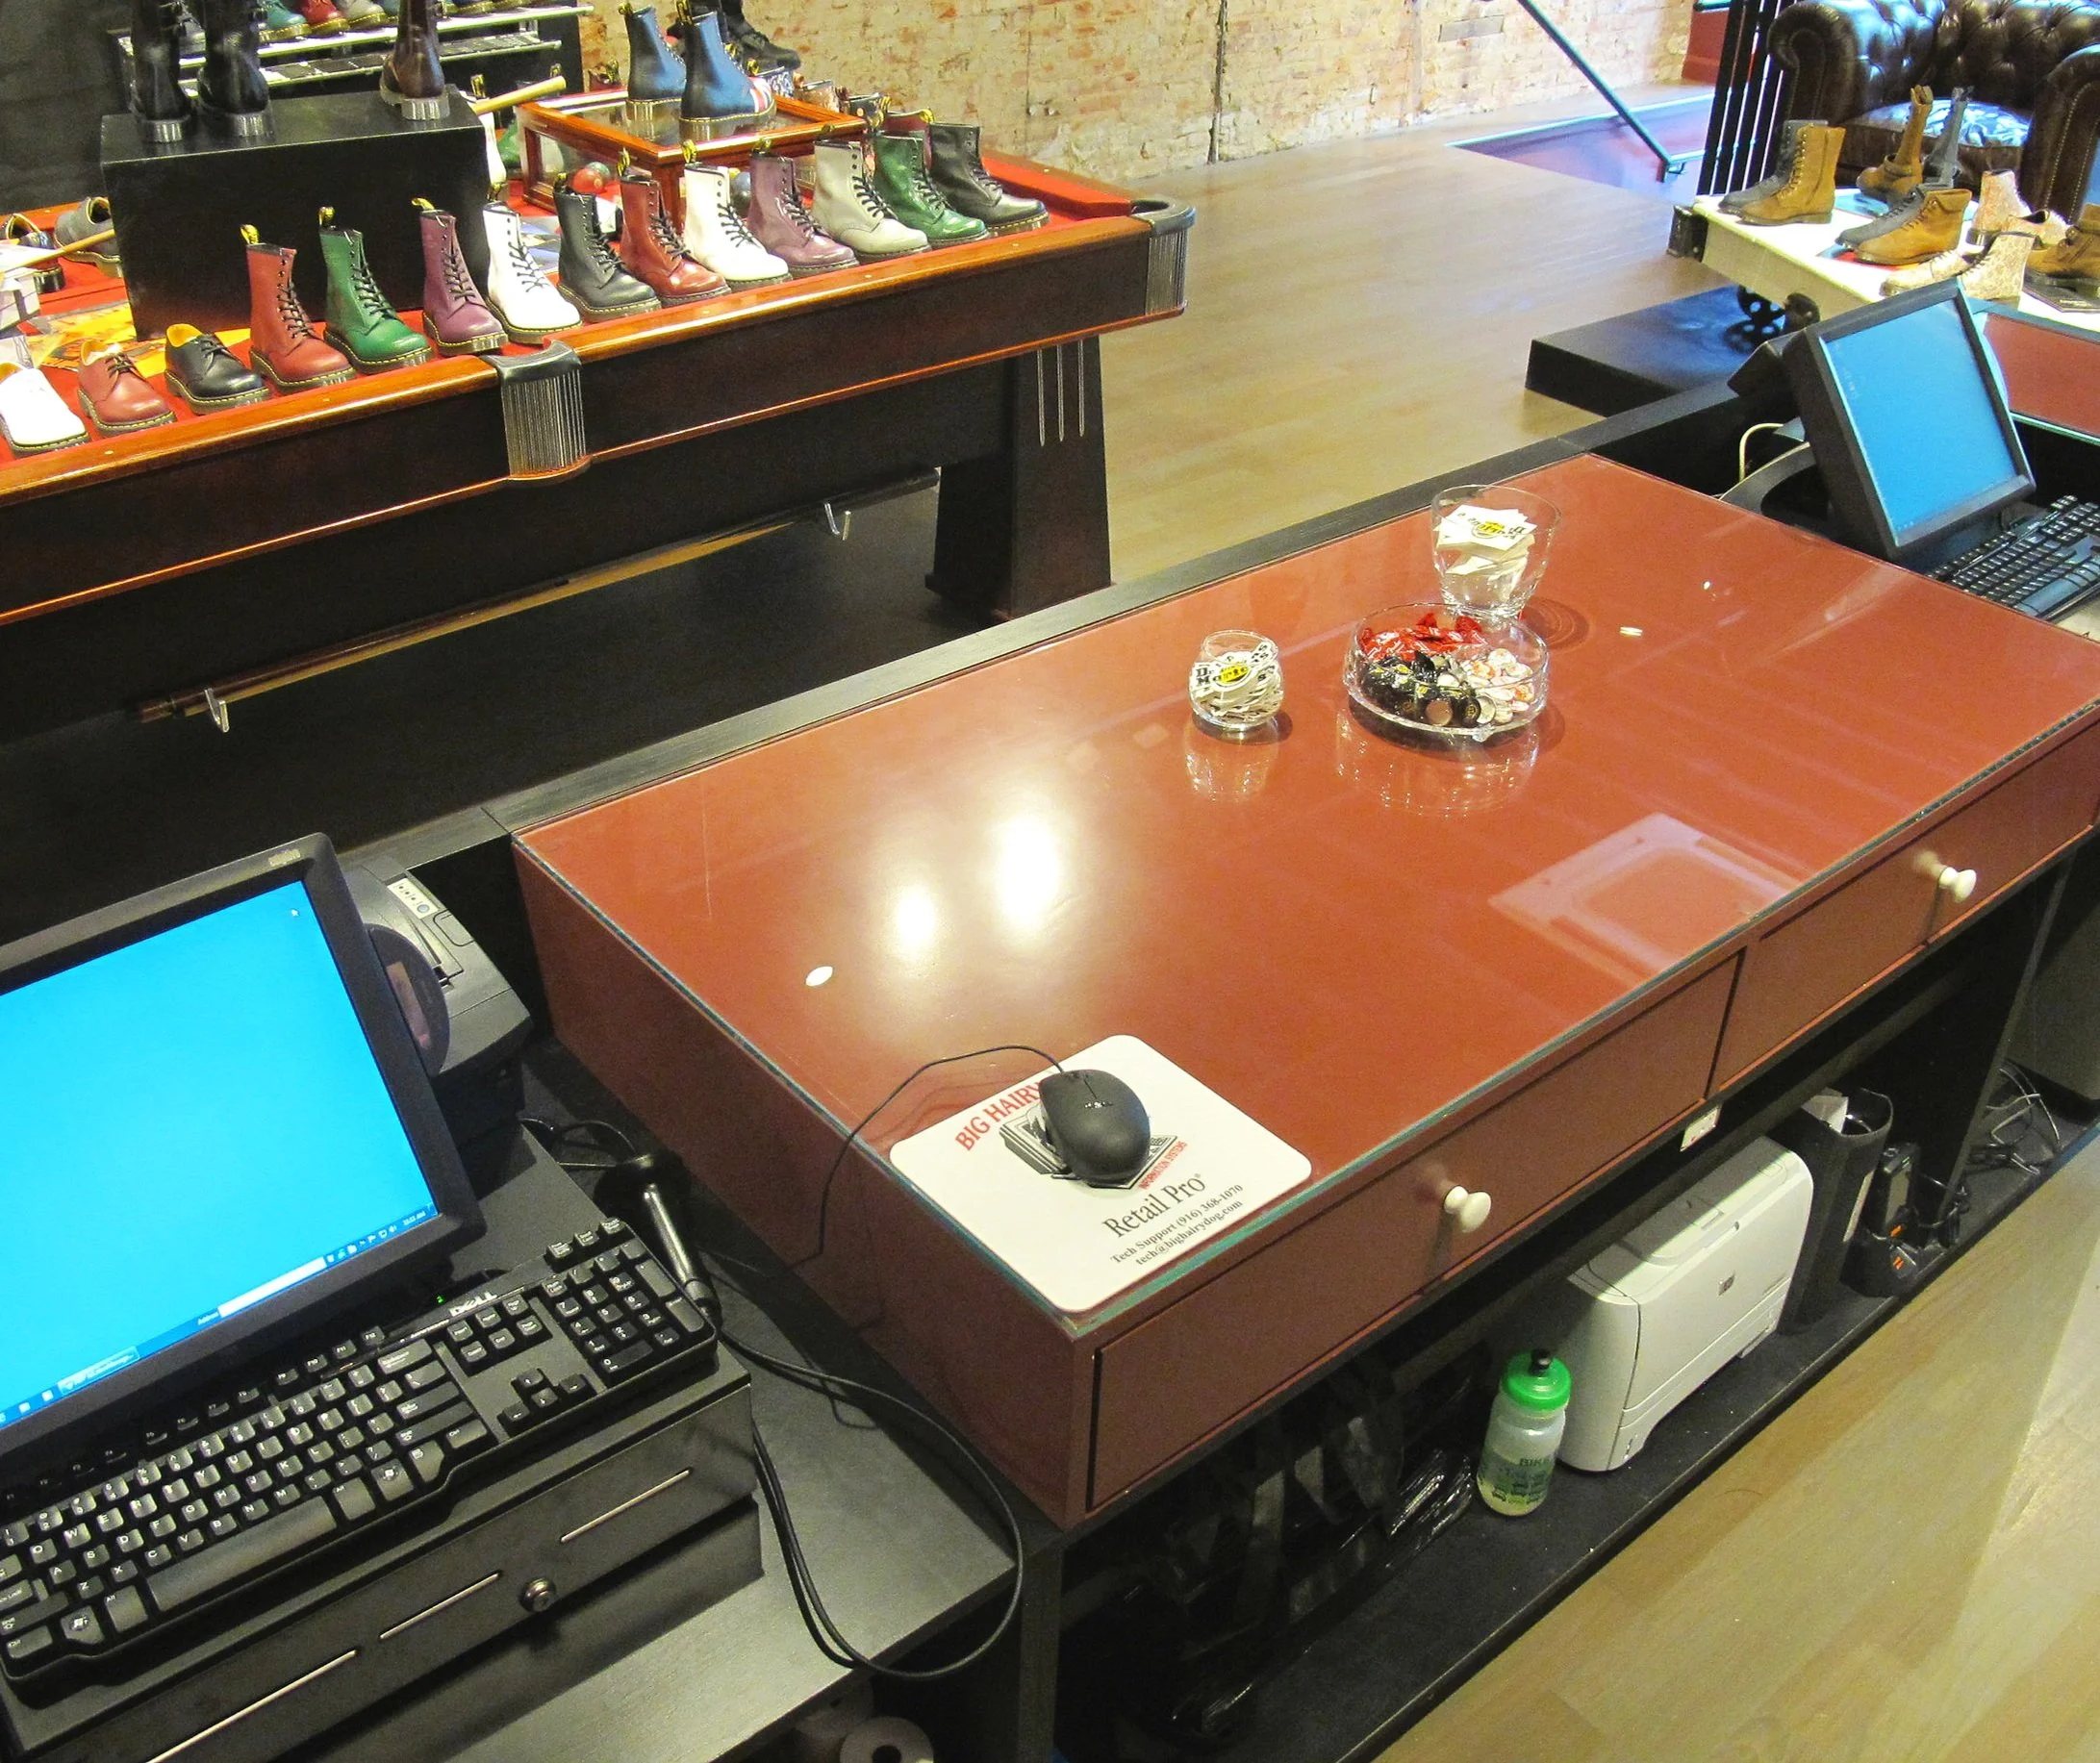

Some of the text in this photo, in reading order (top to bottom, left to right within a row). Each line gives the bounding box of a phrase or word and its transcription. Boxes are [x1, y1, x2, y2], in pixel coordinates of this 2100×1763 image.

[955, 1116, 990, 1151] BIG
[1102, 1194, 1171, 1237] Retail
[1110, 1184, 1244, 1263] Tech Support (916) 368-1070
[1135, 1199, 1244, 1265] tech@bighairydog.com
[448, 1292, 497, 1317] DELL
